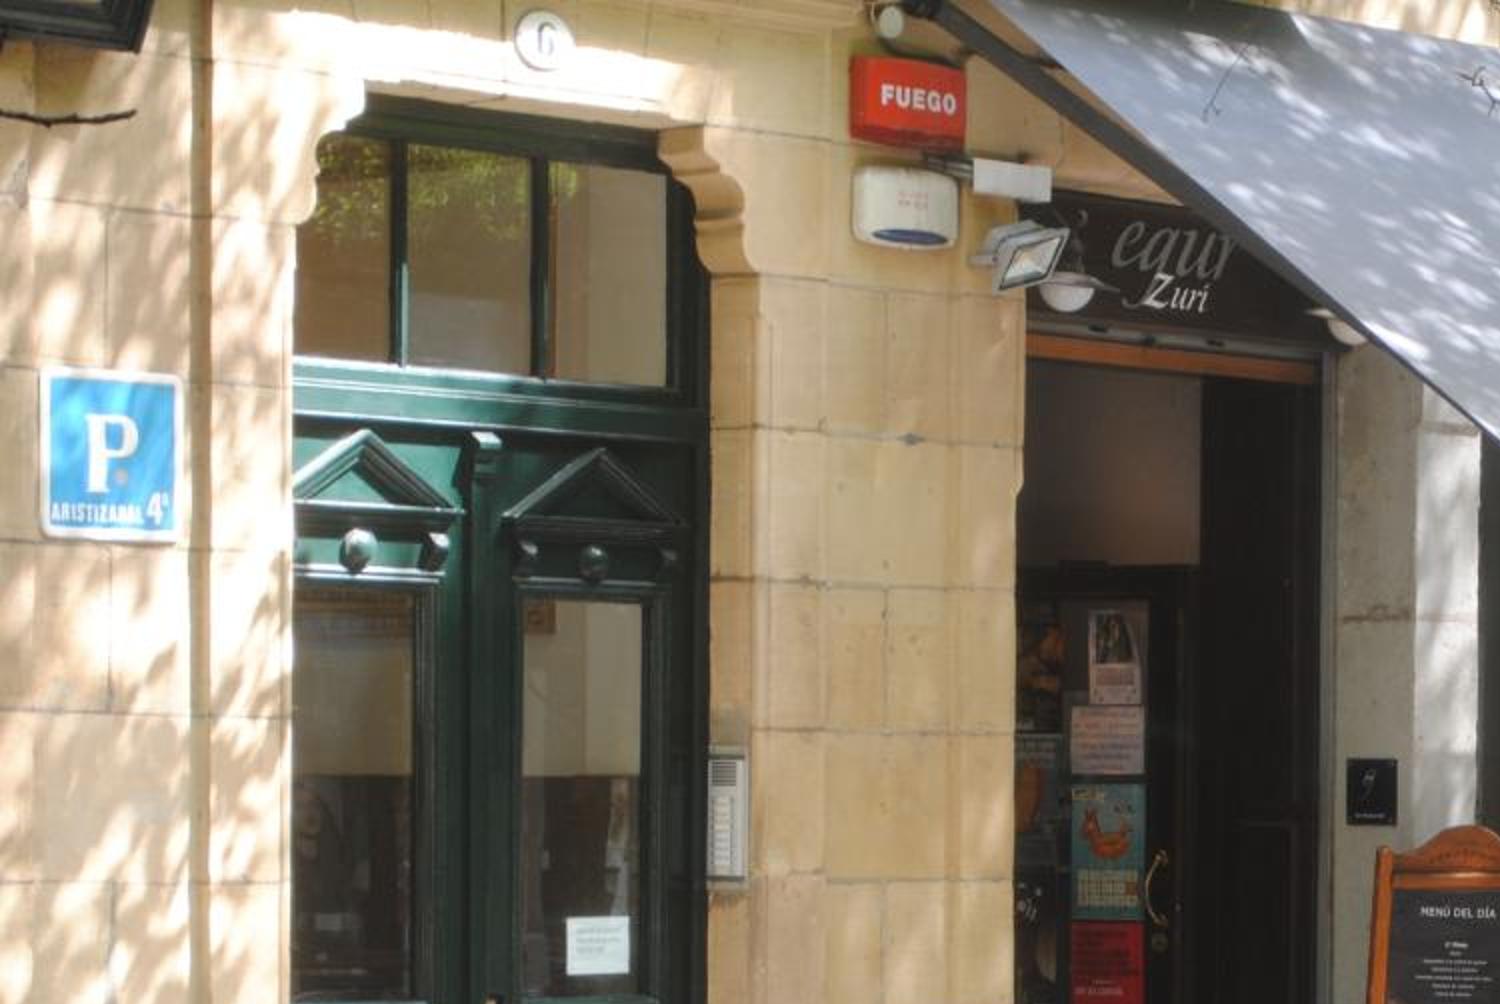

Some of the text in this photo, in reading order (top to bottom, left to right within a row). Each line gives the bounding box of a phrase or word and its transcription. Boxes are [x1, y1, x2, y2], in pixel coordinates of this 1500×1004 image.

[880, 83, 957, 116] FUEGO
[1142, 271, 1211, 313] Zuri
[85, 412, 140, 494] P
[1419, 904, 1498, 920] MENÚ DEL DÍA
